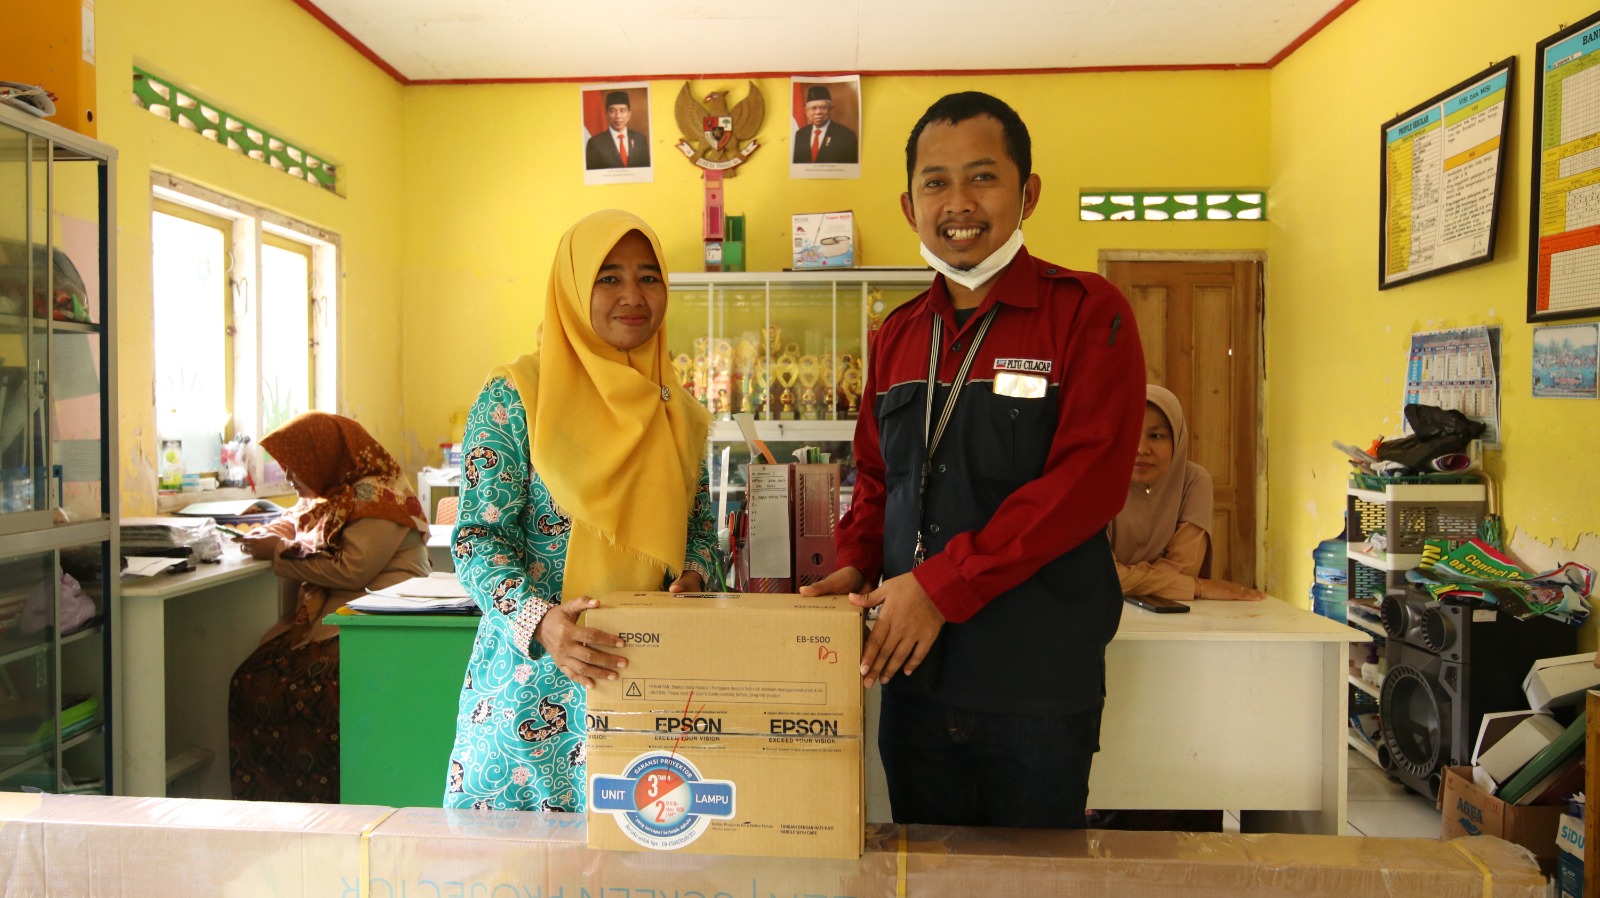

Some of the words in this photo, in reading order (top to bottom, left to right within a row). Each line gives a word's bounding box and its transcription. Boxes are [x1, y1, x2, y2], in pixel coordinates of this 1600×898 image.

[1480, 85, 1491, 95] MISI
[1006, 359, 1022, 369] PLTU
[1023, 361, 1051, 372] CILACAP
[618, 632, 660, 643] EPSON
[796, 635, 831, 643] EB-E500
[655, 717, 722, 734] EPSON
[770, 718, 838, 736] EPSON
[633, 758, 659, 774] GARANSI
[660, 758, 693, 779] PROYEKTOR
[647, 774, 658, 797] 3
[601, 789, 626, 800] UNIT
[695, 794, 729, 805] LAMPU
[655, 800, 666, 823] 2
[1457, 797, 1484, 825] AQUA
